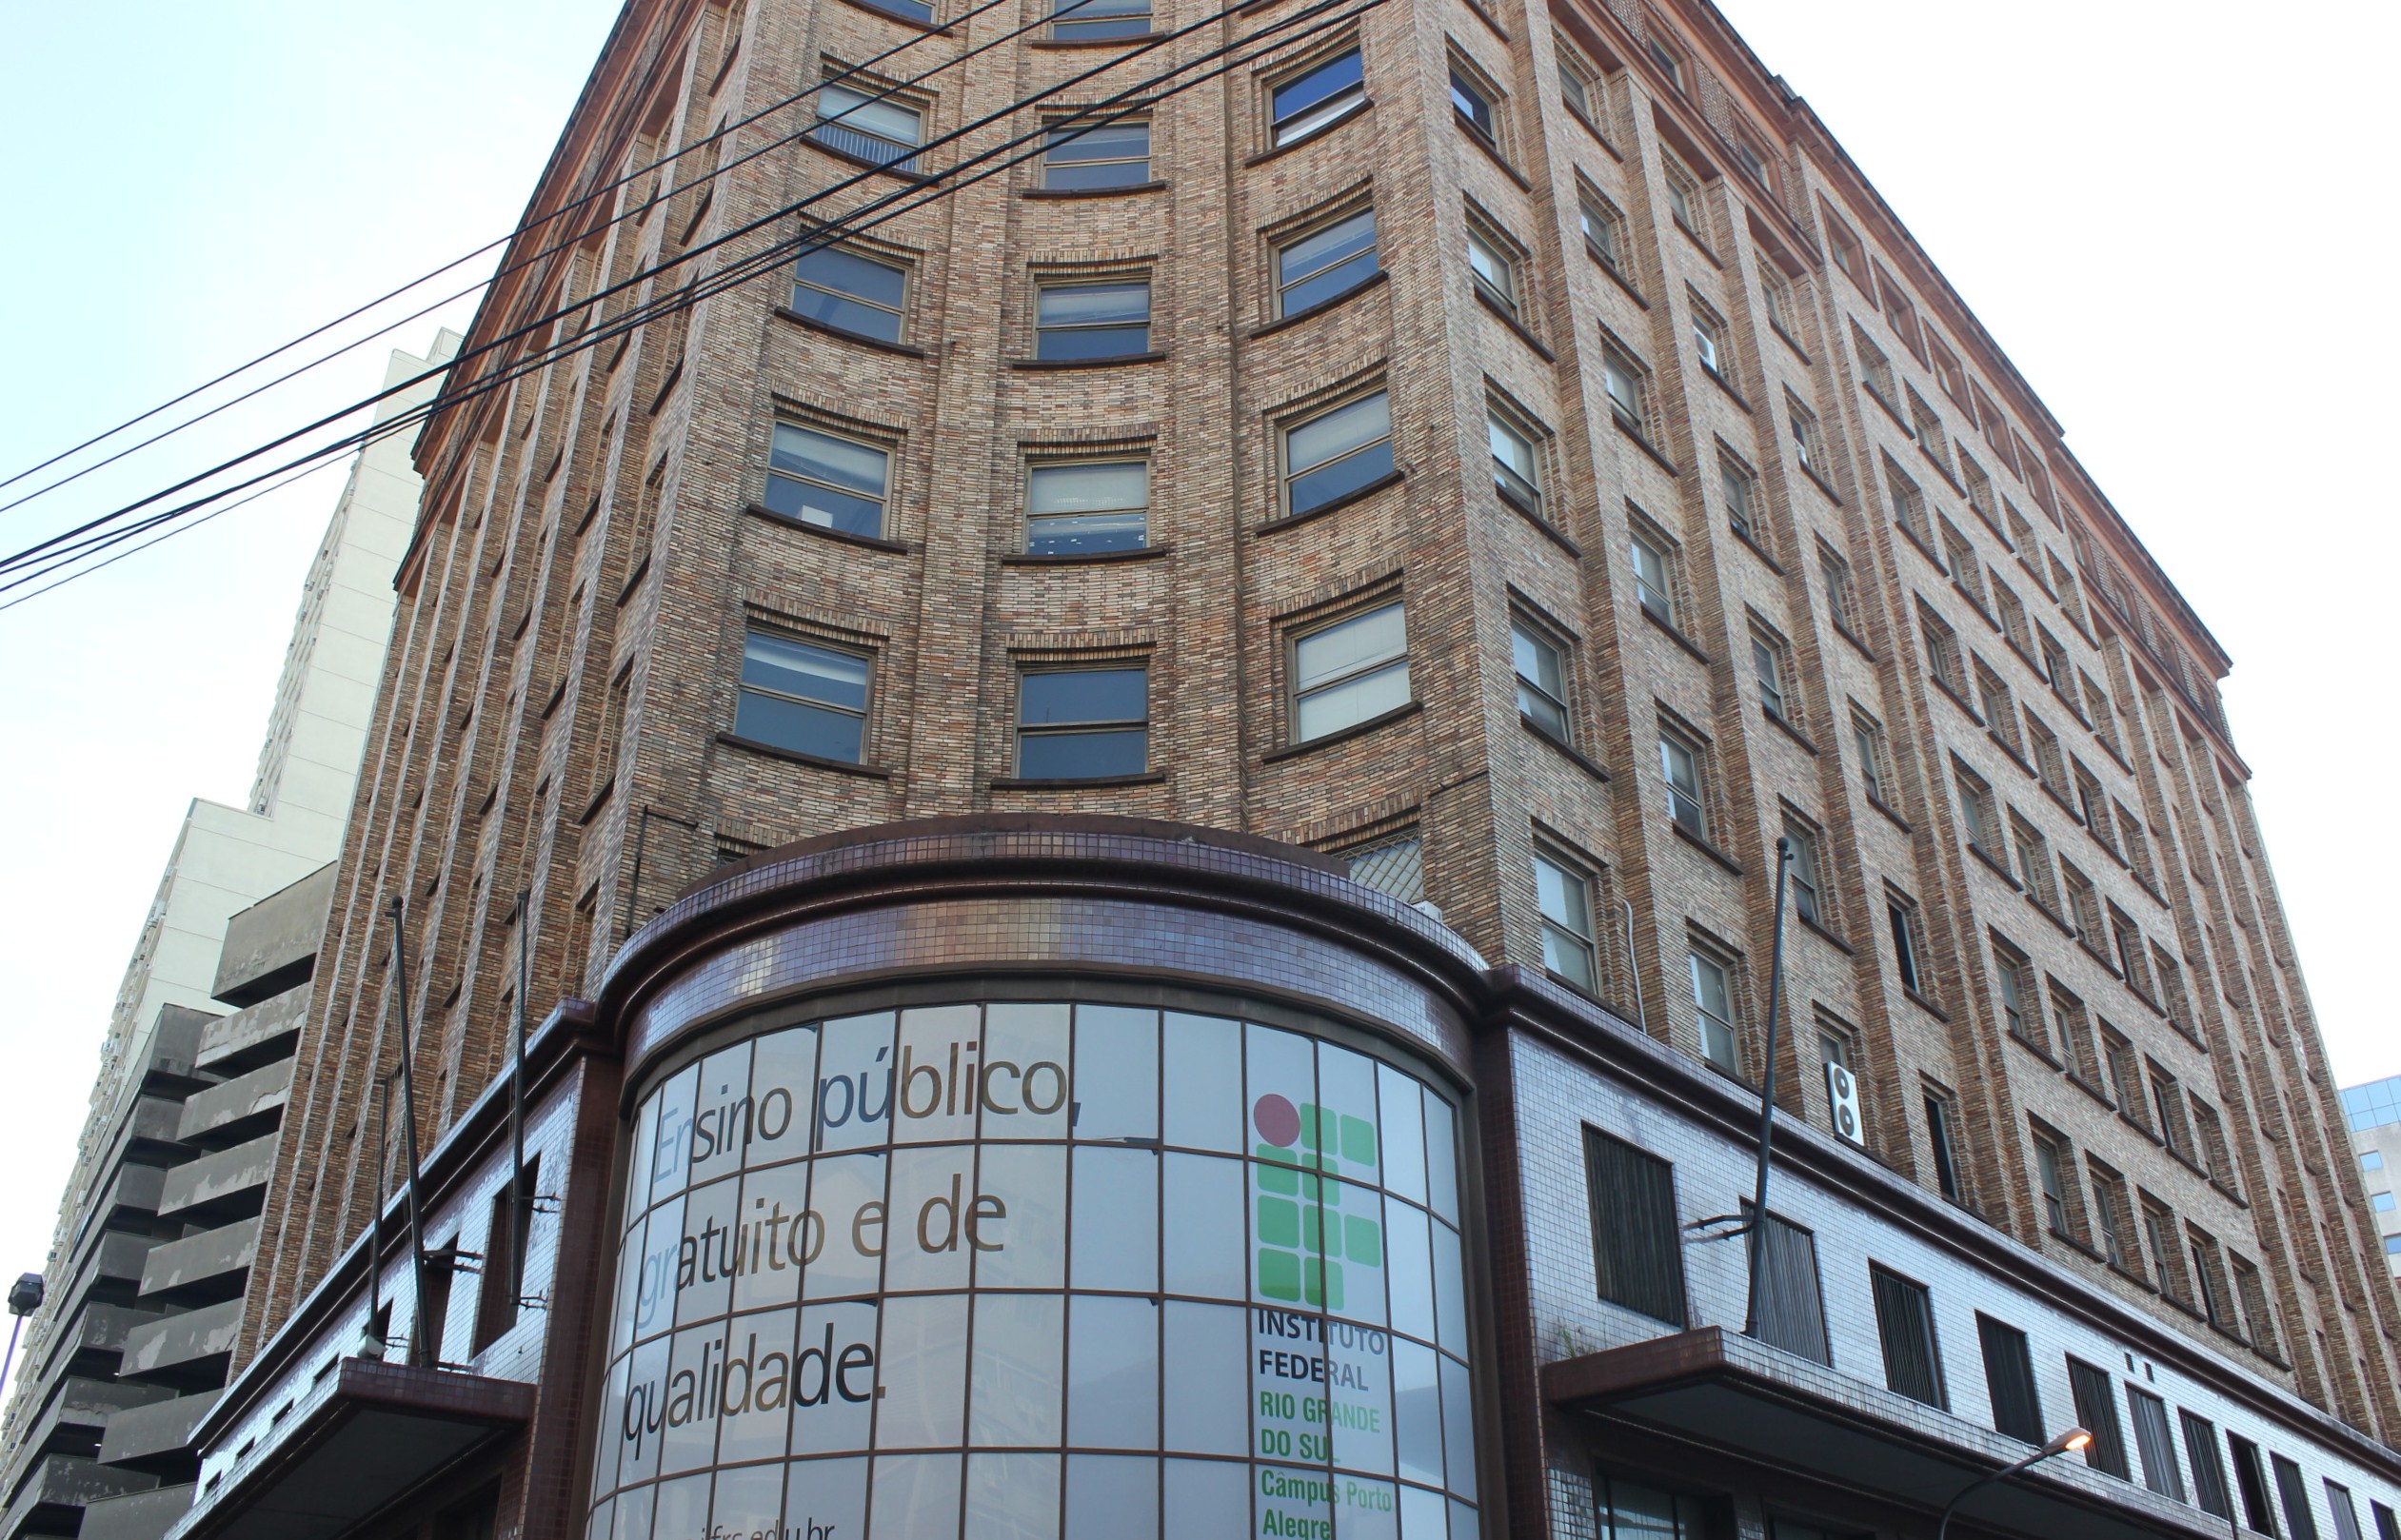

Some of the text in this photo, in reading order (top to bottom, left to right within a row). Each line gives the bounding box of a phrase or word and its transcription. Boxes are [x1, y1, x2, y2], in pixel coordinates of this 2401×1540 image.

[654, 1041, 1081, 1183] Ensino público,
[637, 1174, 1006, 1329] gratuito e de
[1259, 1310, 1385, 1355] INSTITUTO
[625, 1322, 886, 1460] qualidade.
[1260, 1350, 1369, 1392] FEDERAL
[1260, 1391, 1379, 1433] RIO GRANDE
[1261, 1429, 1291, 1457] DO
[1261, 1470, 1392, 1512] Câmpus Porto
[1262, 1509, 1331, 1540] Alegre
